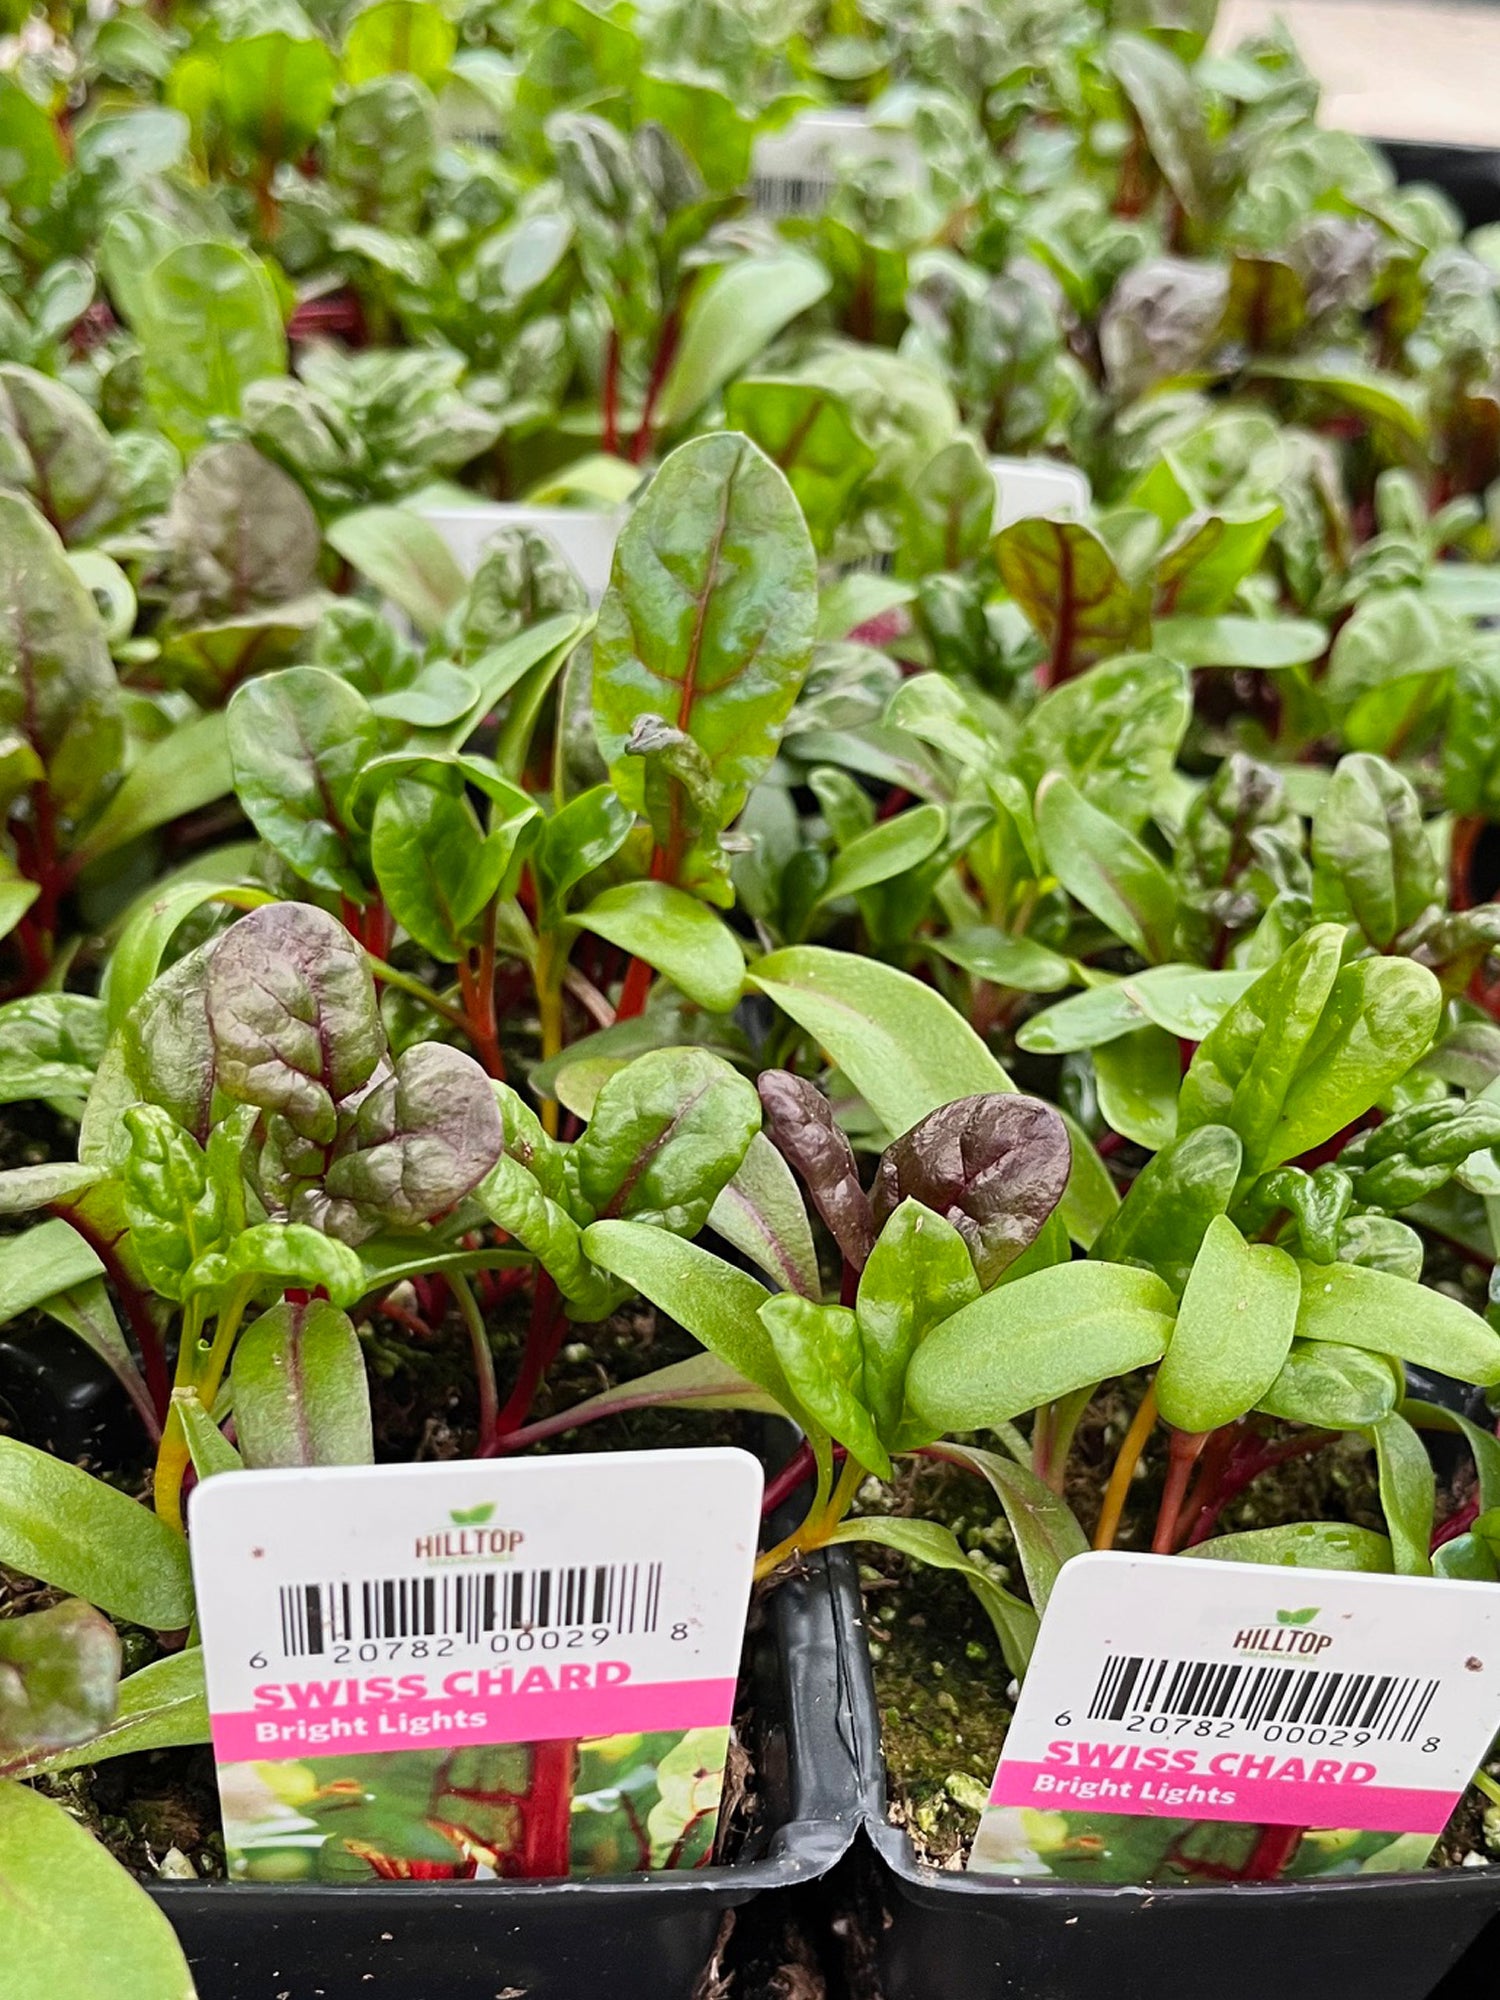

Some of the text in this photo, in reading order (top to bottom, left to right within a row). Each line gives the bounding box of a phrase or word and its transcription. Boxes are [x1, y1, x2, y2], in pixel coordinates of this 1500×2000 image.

[415, 1527, 524, 1558] HILLTOP
[249, 1622, 688, 1669] 6 20782 00029 8
[1232, 1628, 1333, 1654] HILLTOP
[253, 1660, 632, 1711] SWISS CHARD
[255, 1709, 488, 1744] Bright Lights
[1055, 1709, 1441, 1753] 6 20782 00029 8
[1044, 1740, 1377, 1784] SWISS CHARD
[1033, 1774, 1236, 1806] Bright Lights
